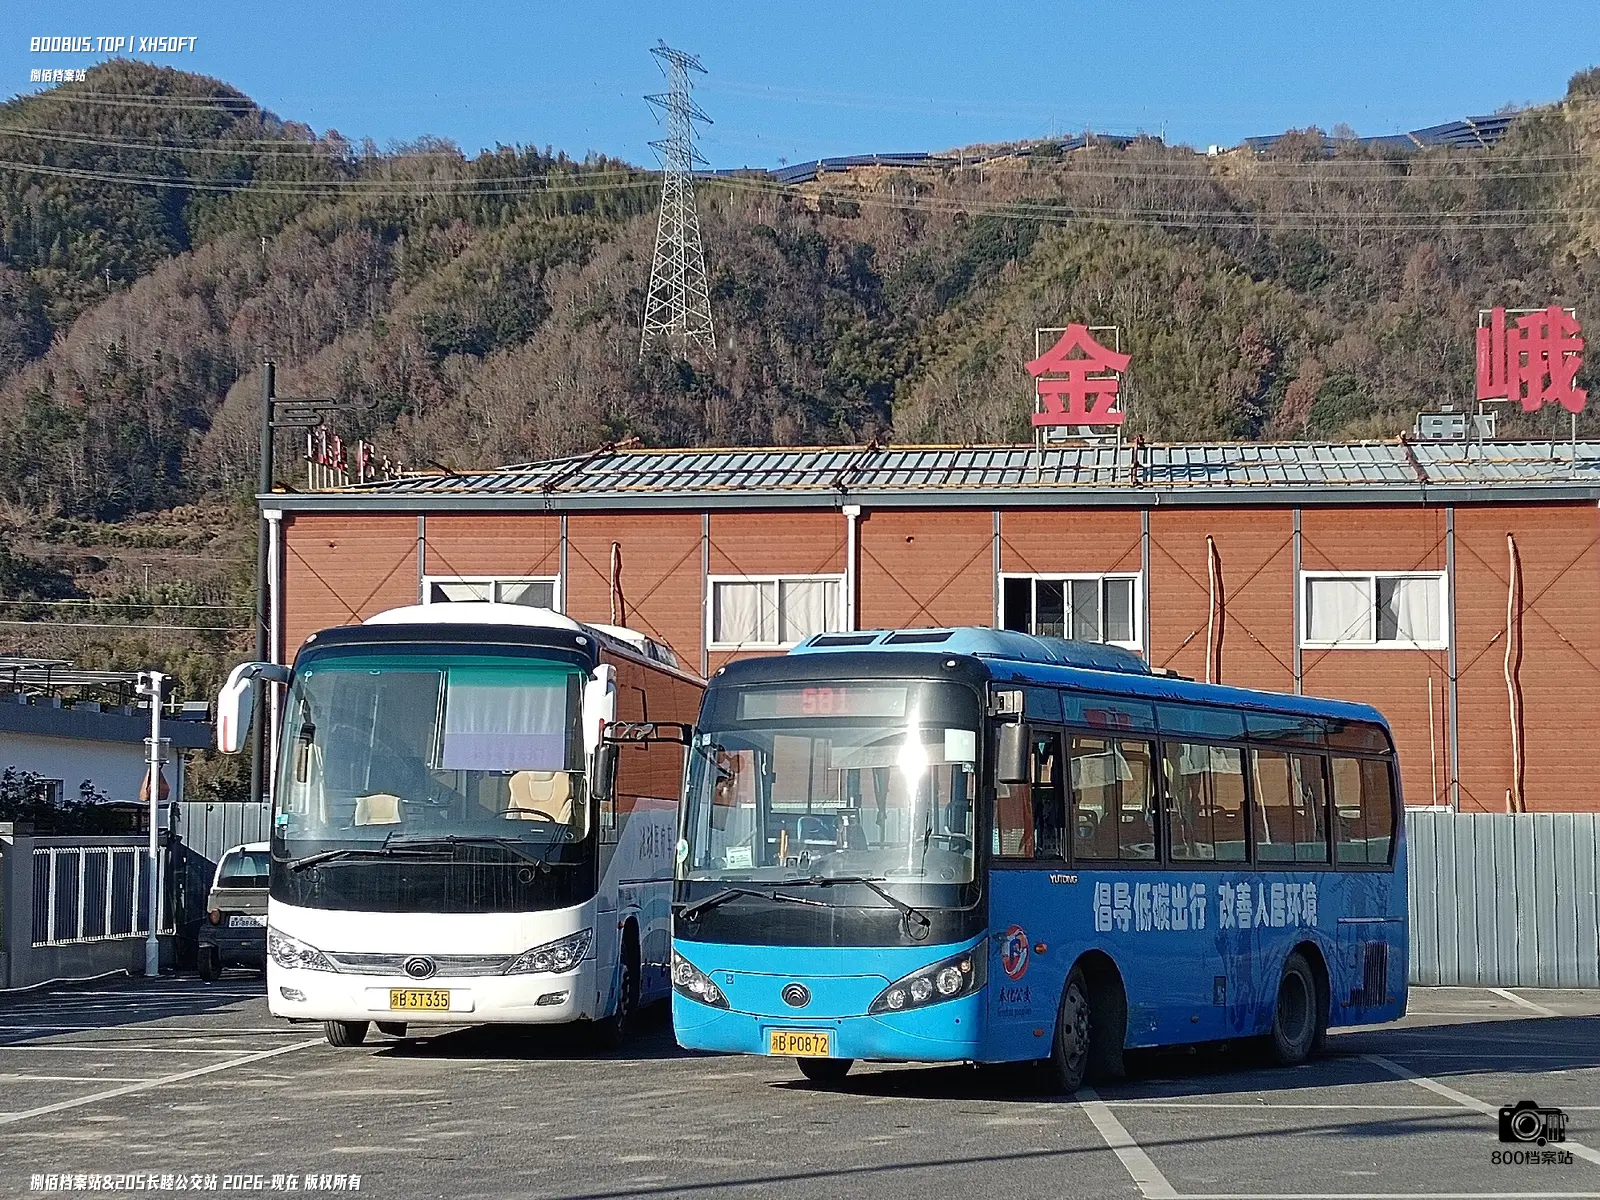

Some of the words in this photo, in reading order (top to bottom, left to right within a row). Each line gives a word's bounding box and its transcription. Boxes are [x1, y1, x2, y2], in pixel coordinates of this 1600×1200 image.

[1024, 323, 1131, 426] 金
[1476, 306, 1588, 414] 峨
[1049, 874, 1078, 884] YUTONG
[1093, 881, 1207, 932] 倡导低碳出行
[1218, 881, 1318, 930] 改善人居环境
